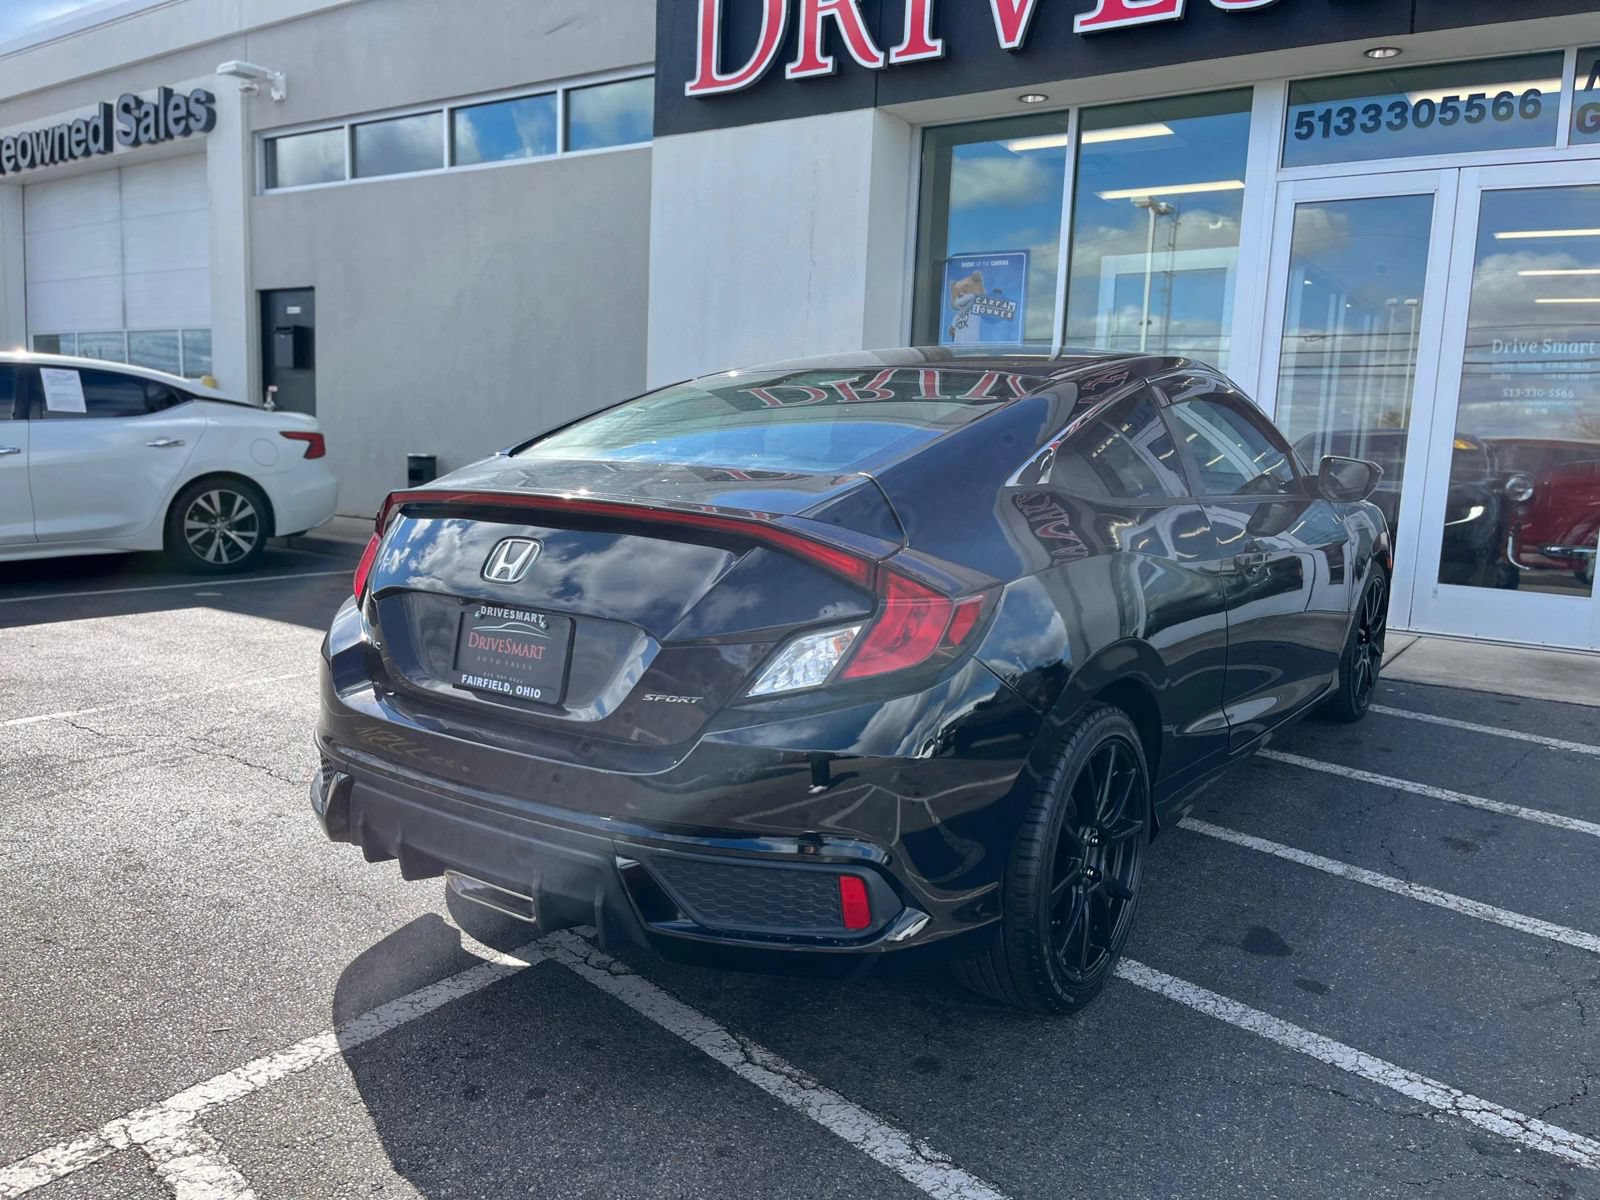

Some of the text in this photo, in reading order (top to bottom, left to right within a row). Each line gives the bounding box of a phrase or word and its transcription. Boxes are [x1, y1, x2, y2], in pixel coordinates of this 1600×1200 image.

[116, 86, 216, 147] Sales
[1294, 88, 1542, 141] 5133305566
[975, 297, 1016, 311] CARFAX
[1491, 338, 1595, 354] Drive Smart
[480, 605, 545, 624] DRIVESMART
[461, 674, 513, 695] FAIRFIELD,
[516, 685, 541, 699] OHIO
[642, 693, 704, 704] SPORT
